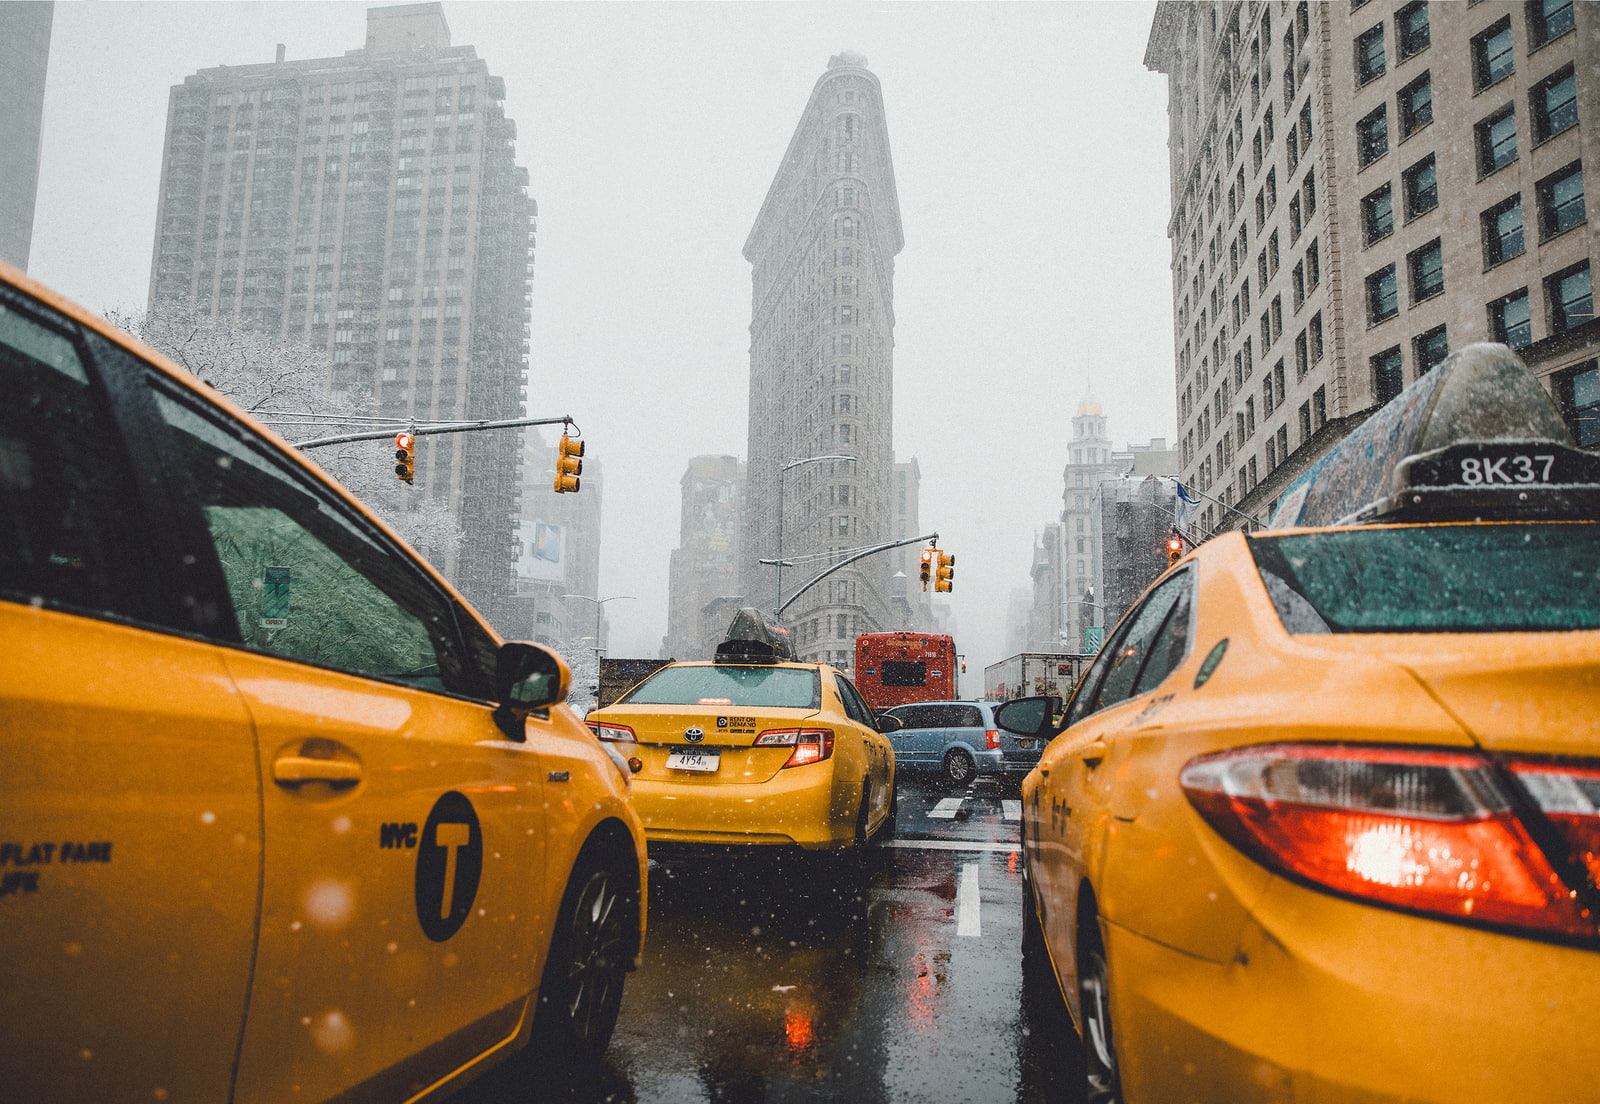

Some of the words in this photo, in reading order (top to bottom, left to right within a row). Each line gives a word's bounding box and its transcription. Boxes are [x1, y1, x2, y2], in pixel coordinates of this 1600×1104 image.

[1460, 455, 1555, 485] 8K37
[380, 822, 418, 849] NYC
[60, 842, 113, 864] FARE
[435, 822, 470, 920] T
